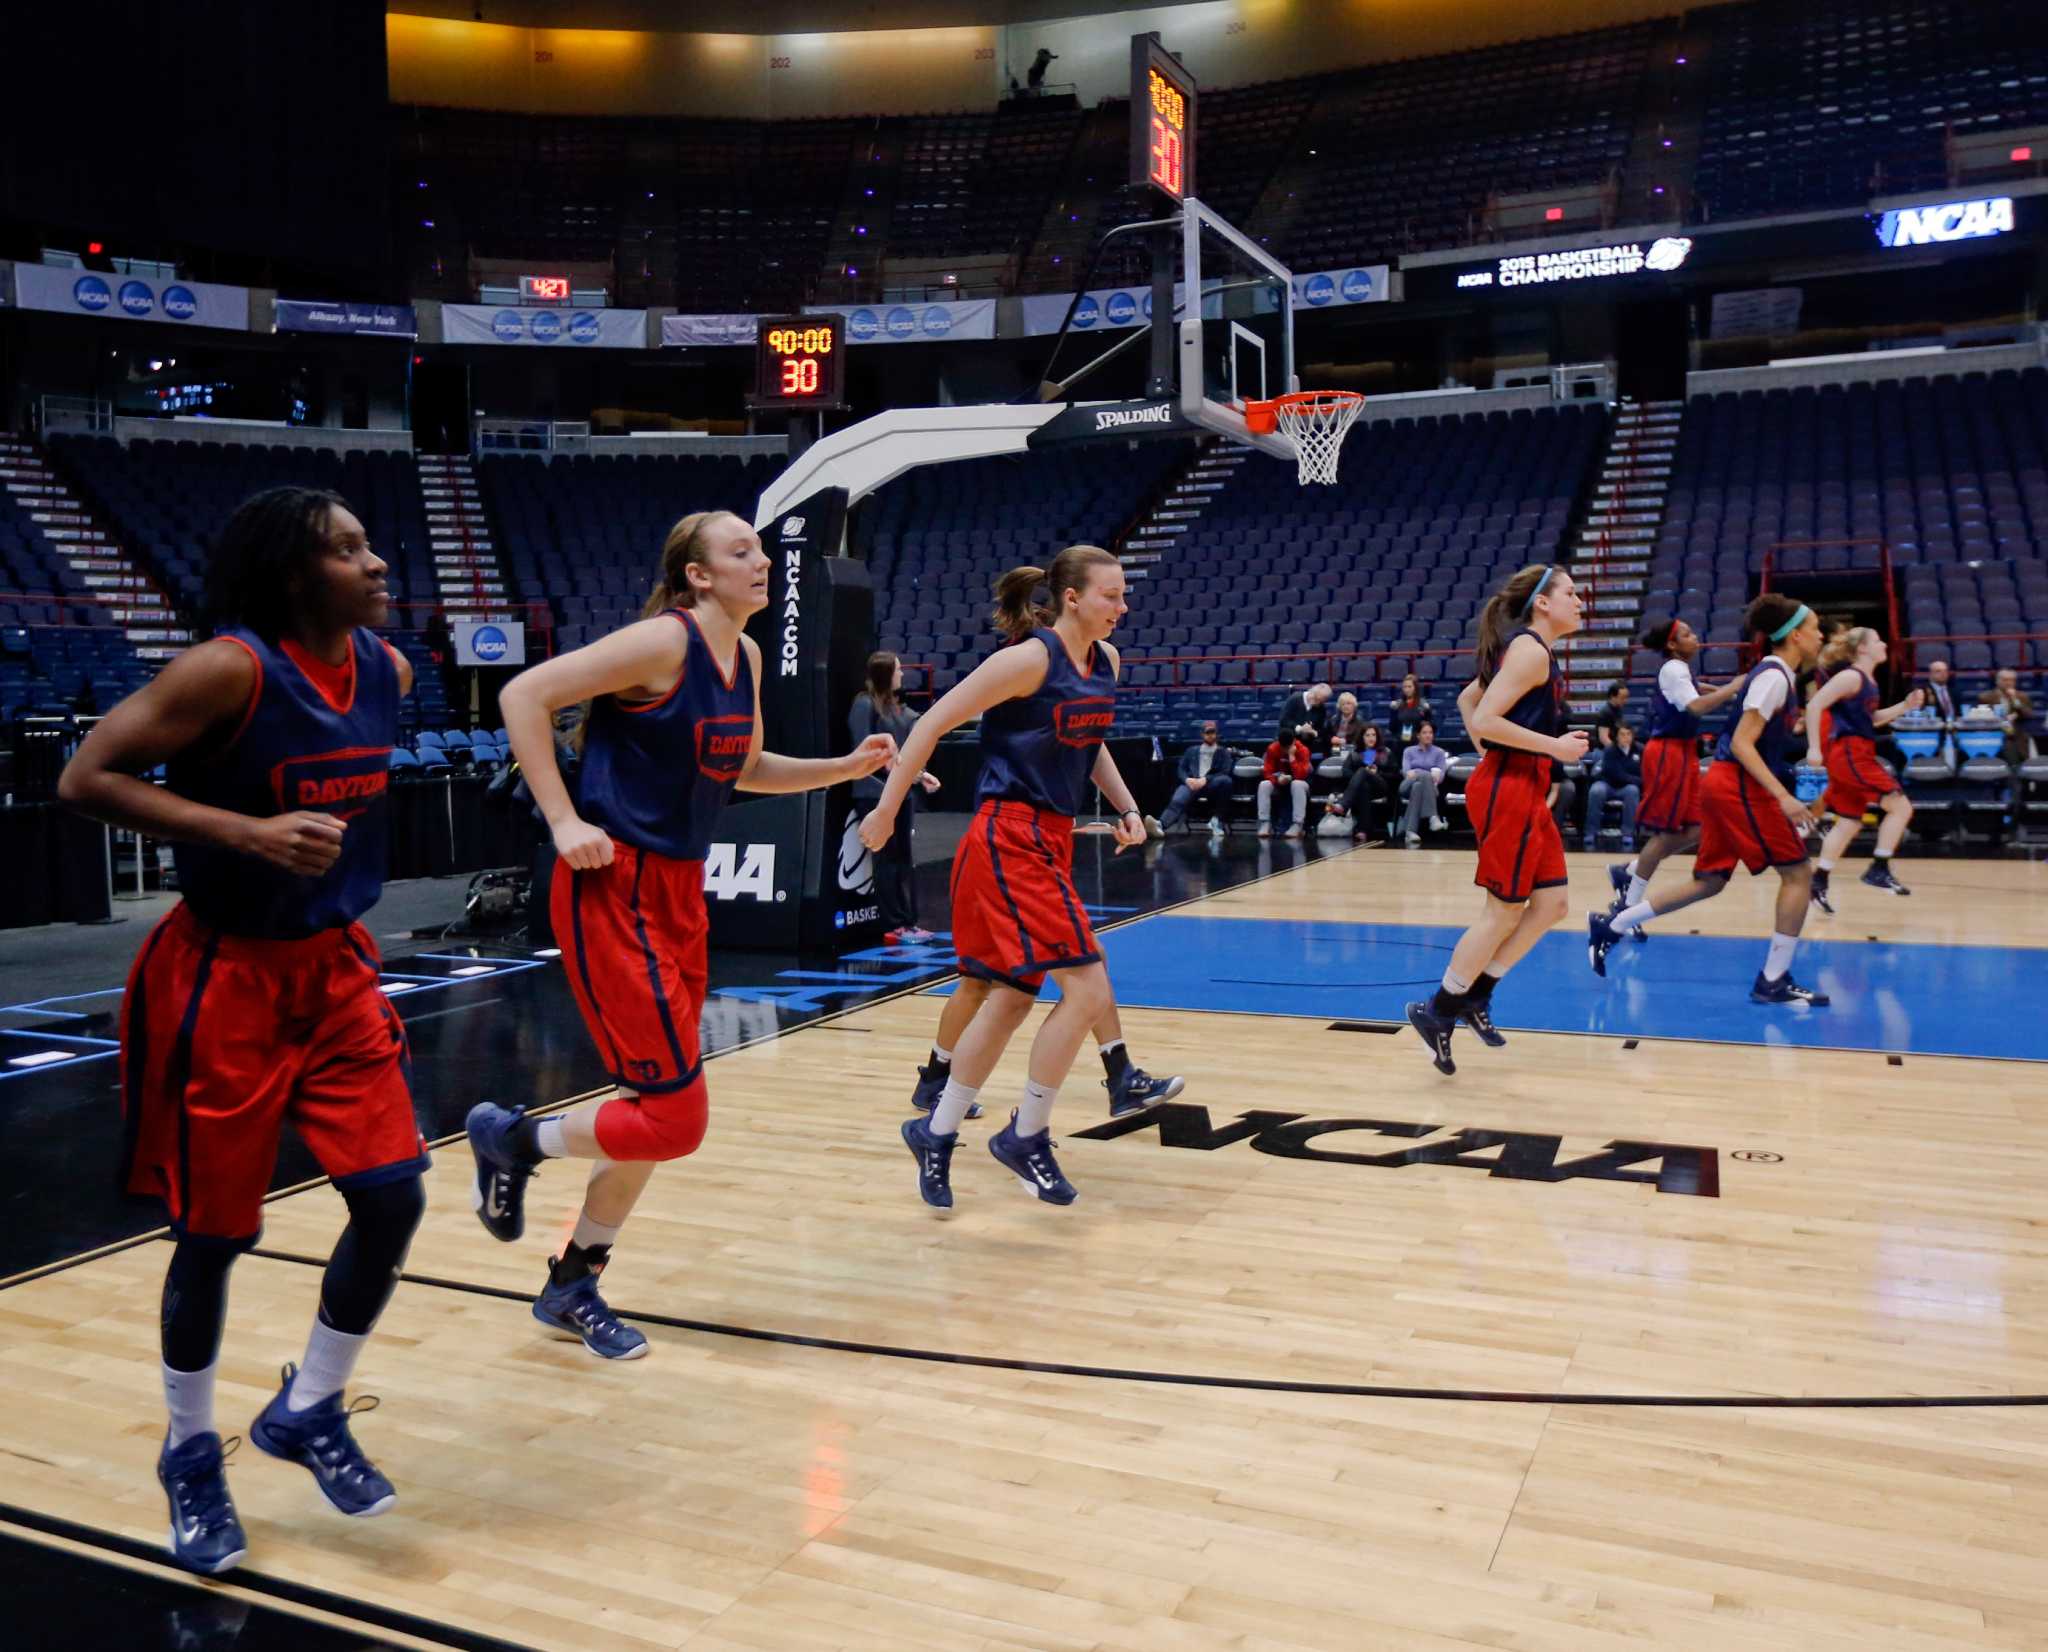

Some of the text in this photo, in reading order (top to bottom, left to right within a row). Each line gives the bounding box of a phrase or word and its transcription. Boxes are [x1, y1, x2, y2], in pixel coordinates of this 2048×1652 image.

[770, 57, 791, 68] 202
[1152, 117, 1182, 194] 30
[1892, 197, 2014, 247] NCAA
[1499, 244, 1644, 272] 2015 BASKETBALL
[1457, 258, 1644, 288] NCAA CHAMPIONSHIP
[77, 292, 196, 313] NCAA NCAA NCAA
[1073, 309, 1098, 320] CAA
[349, 313, 372, 324] New
[374, 314, 397, 325] York
[768, 328, 832, 355] 90:00
[783, 359, 818, 394] 30
[1096, 403, 1172, 431] SPALDING
[781, 550, 801, 677] NCAA.COM
[475, 641, 507, 653] NCAA
[704, 843, 776, 901] AA
[1066, 1102, 1720, 1198] NCAA
